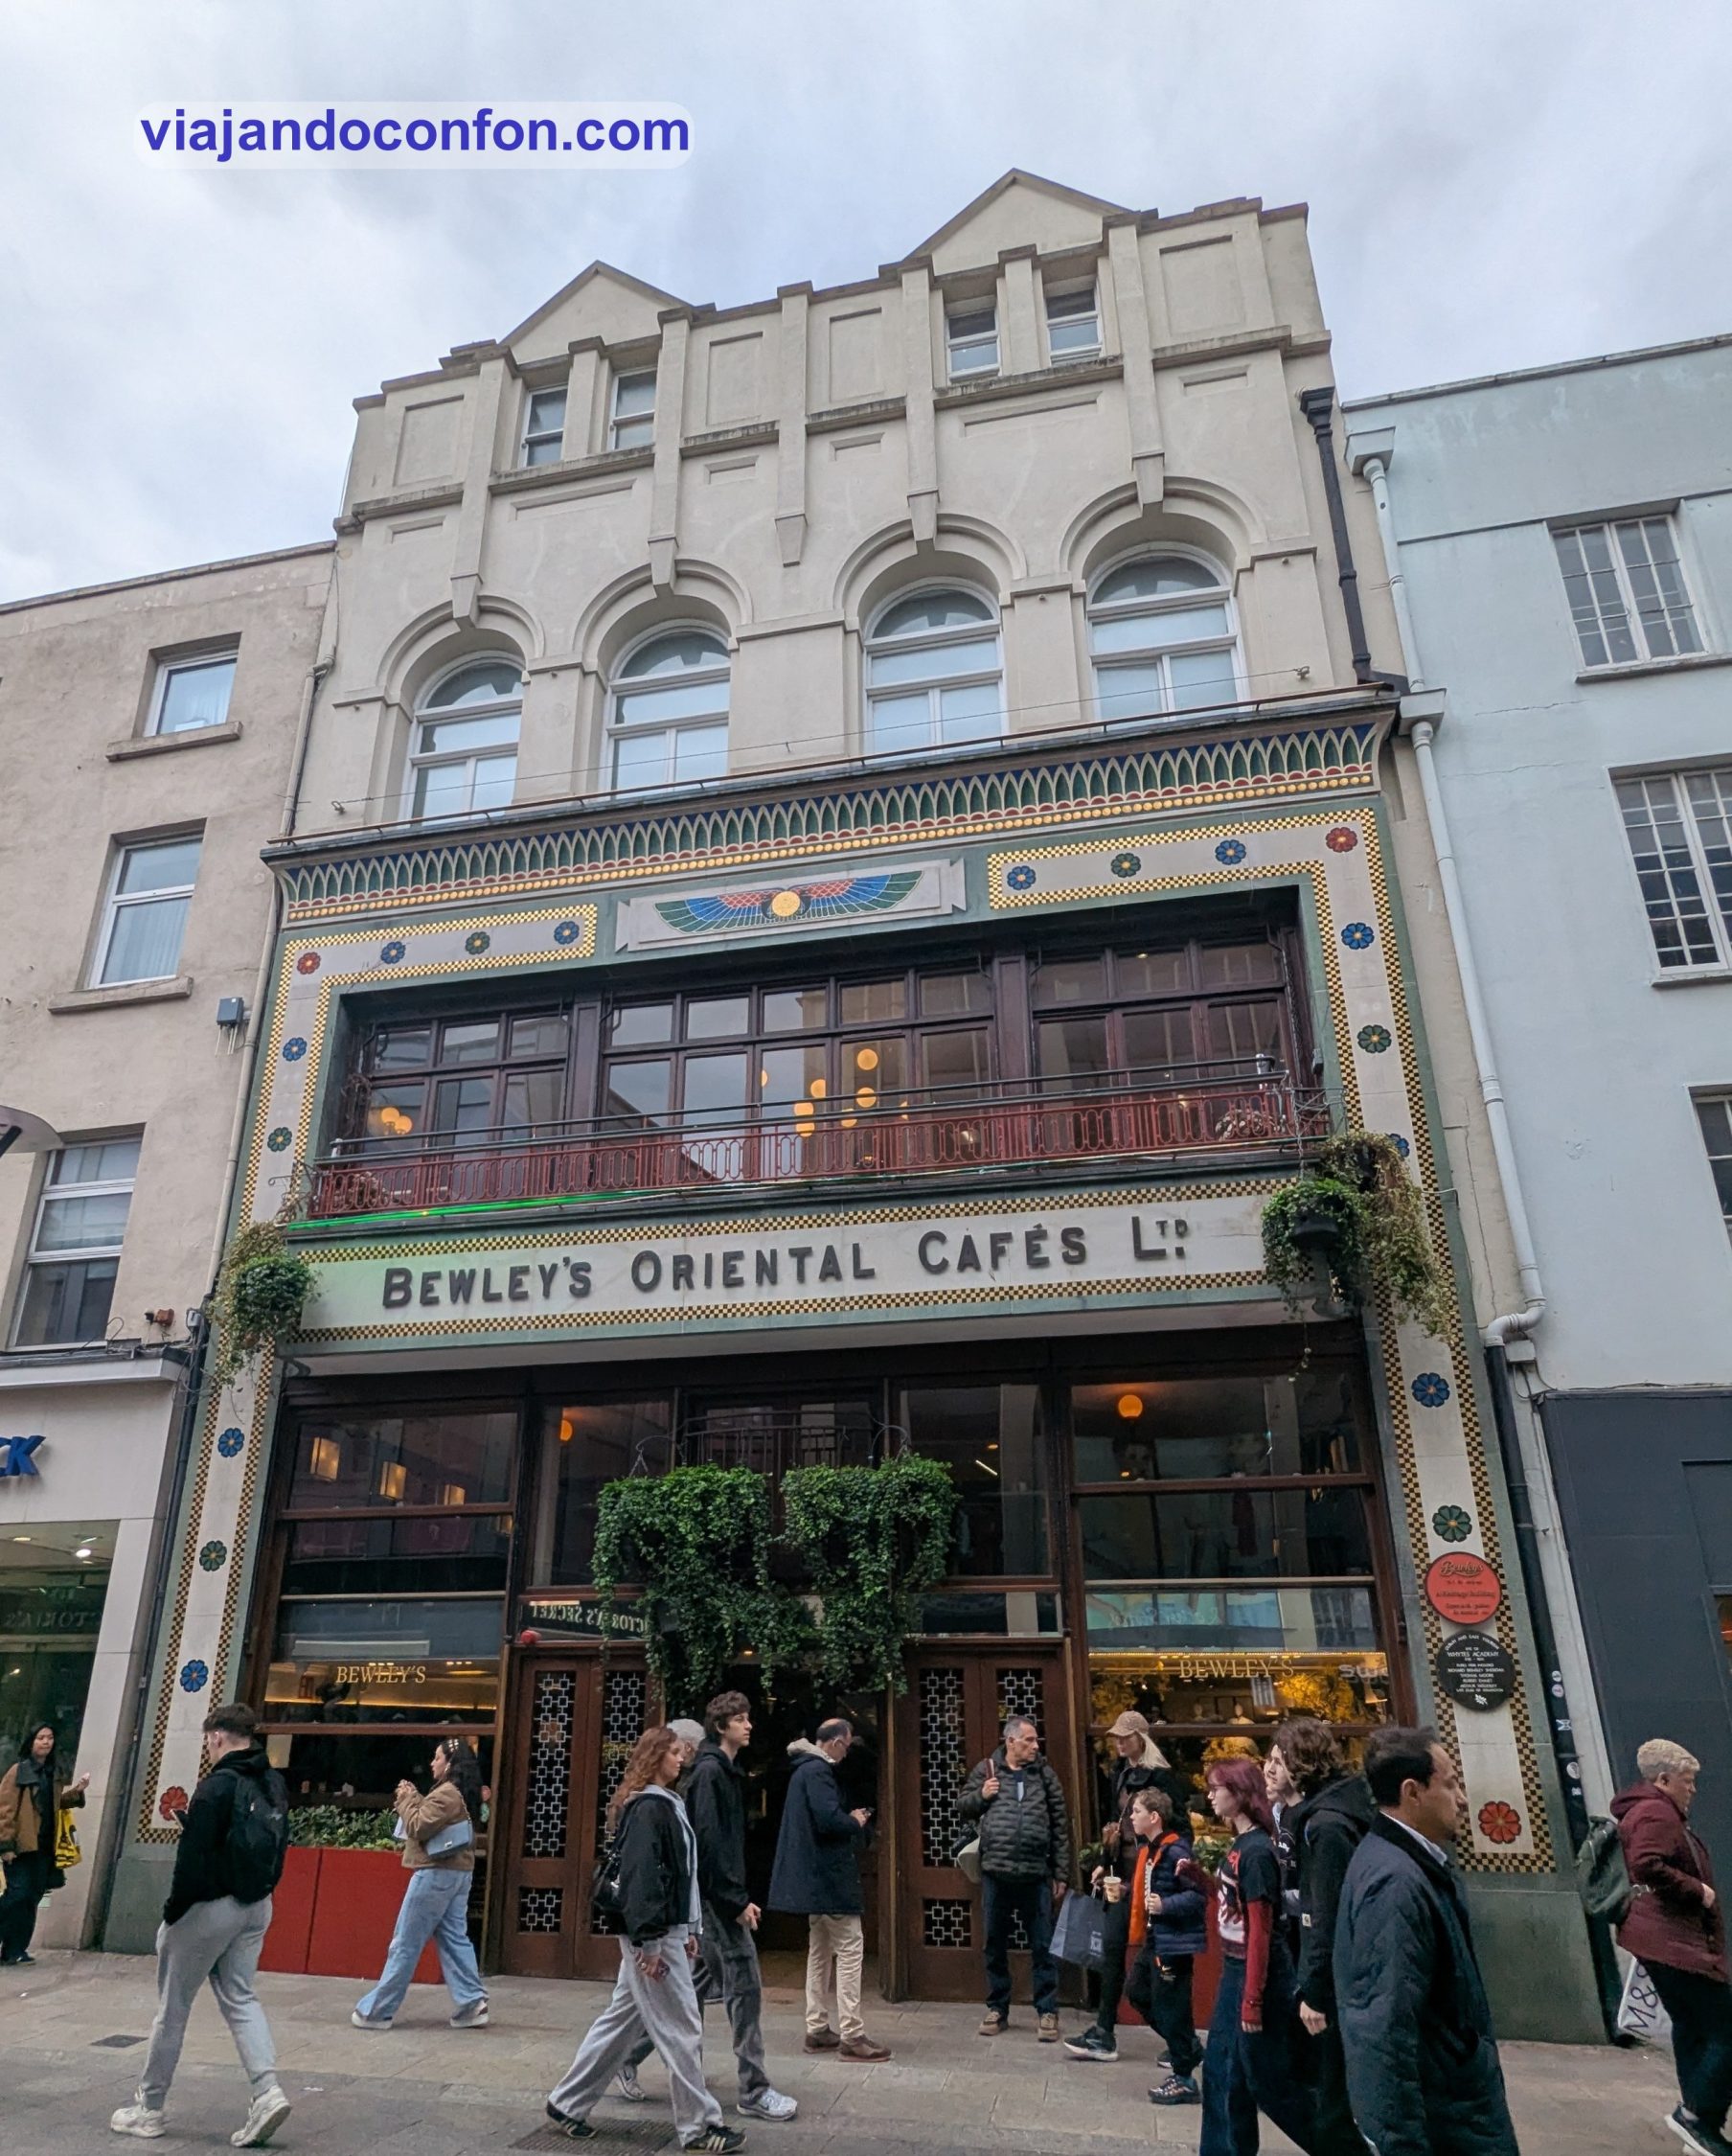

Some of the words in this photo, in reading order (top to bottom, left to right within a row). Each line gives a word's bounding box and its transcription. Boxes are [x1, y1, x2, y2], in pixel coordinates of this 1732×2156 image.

[380, 1256, 593, 1309] BEWLEY'S
[630, 1243, 877, 1293] ORIENTAL
[917, 1220, 1088, 1275] CAFÉS
[335, 1665, 426, 1684] BEWLEY'S
[1178, 1658, 1295, 1679] BEWLEY'S
